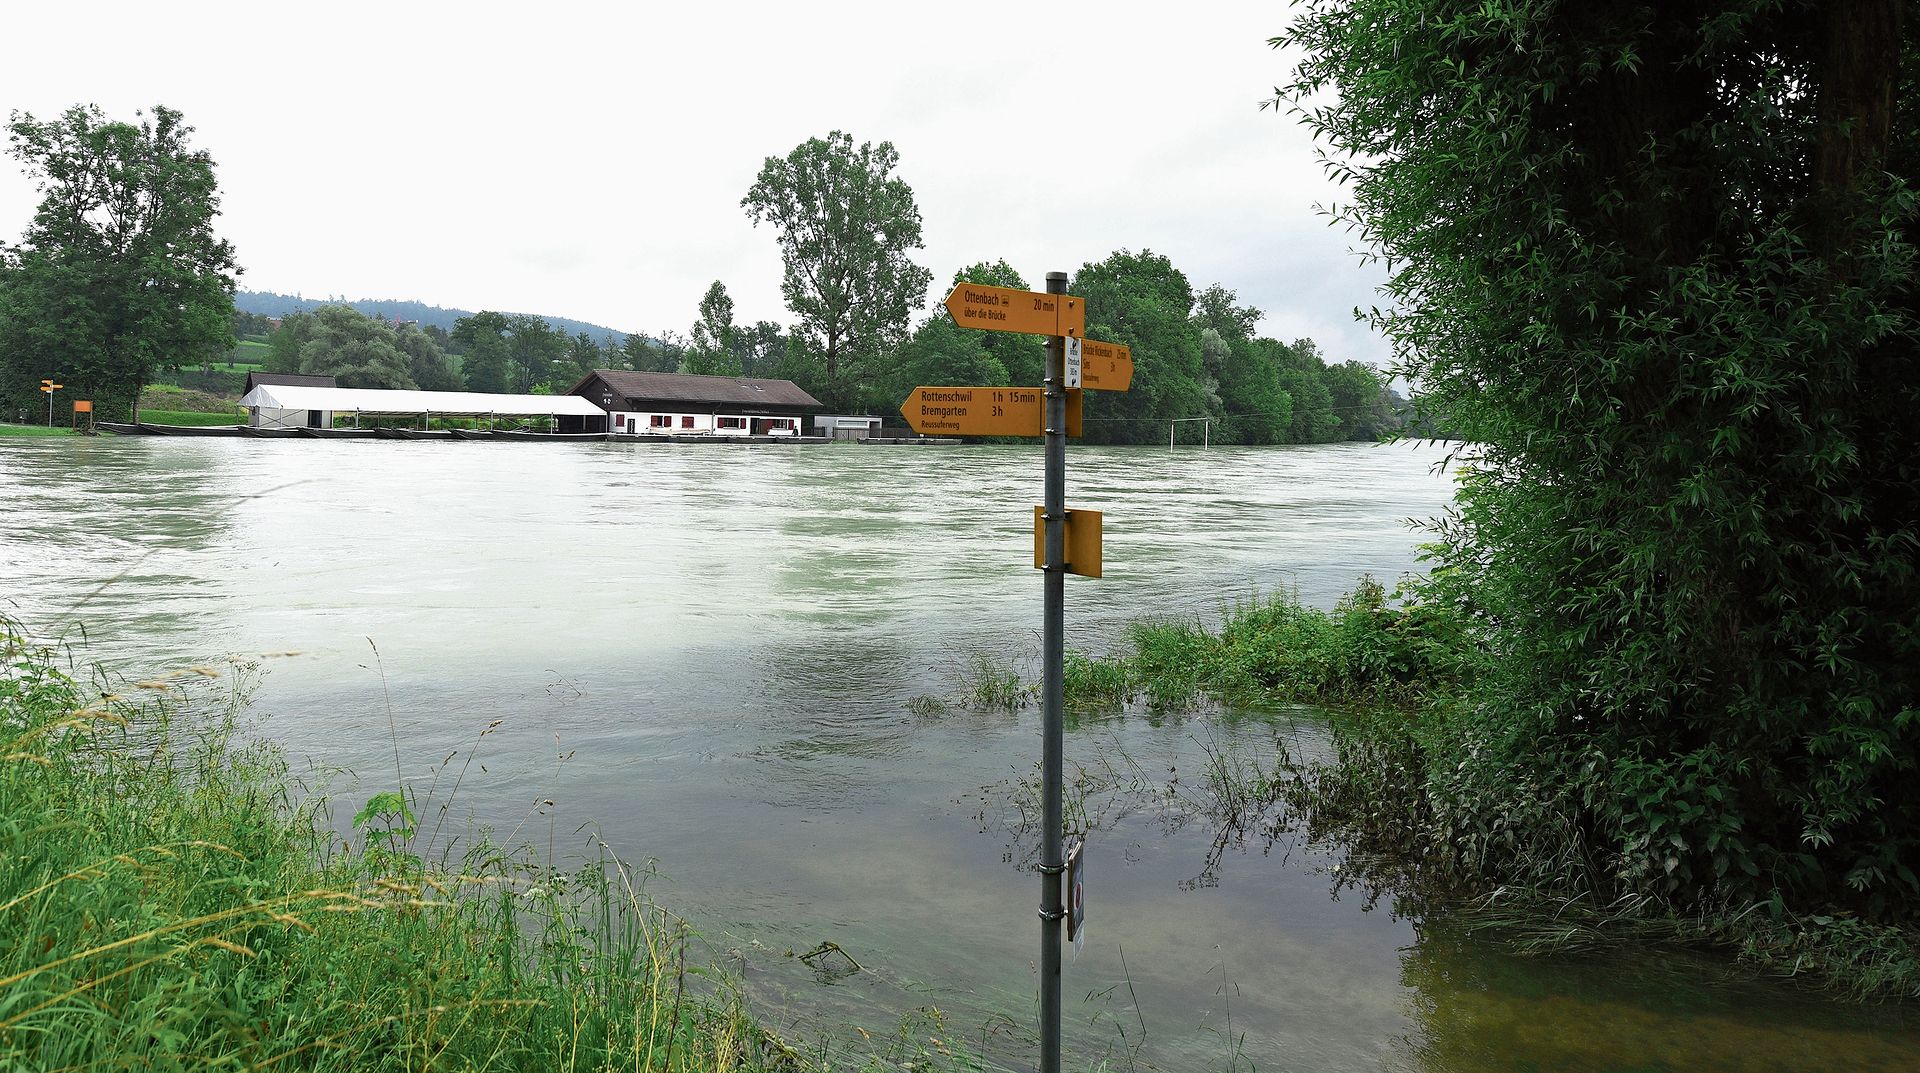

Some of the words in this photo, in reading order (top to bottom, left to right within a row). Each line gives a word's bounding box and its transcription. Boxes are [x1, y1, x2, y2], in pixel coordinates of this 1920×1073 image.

[964, 290, 999, 306] Ottenbach
[1033, 298, 1042, 311] 20
[1042, 300, 1054, 312] min
[964, 309, 978, 318] über
[978, 310, 987, 319] die
[988, 310, 1006, 321] Brücke
[921, 390, 972, 402] Rottenschwil
[921, 404, 967, 419] Bremgarten
[921, 420, 960, 430] Reussuferweg
